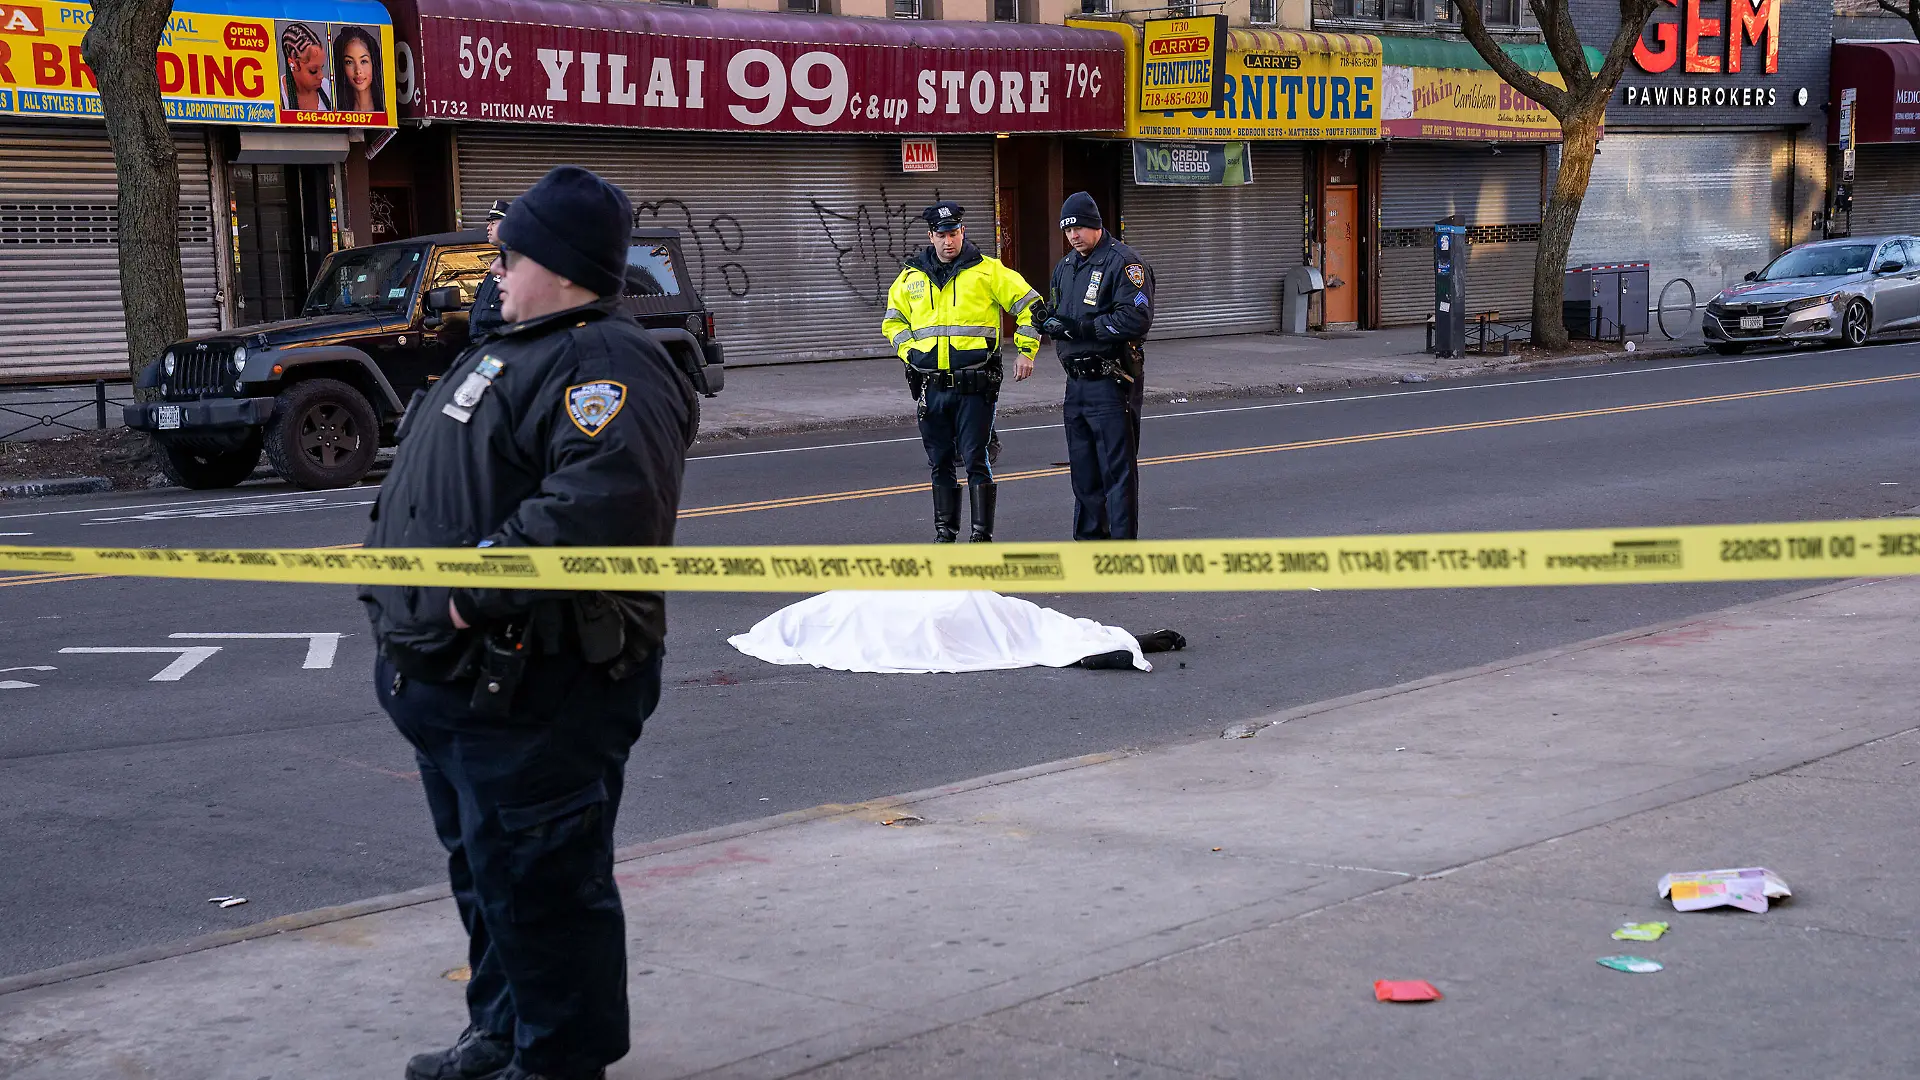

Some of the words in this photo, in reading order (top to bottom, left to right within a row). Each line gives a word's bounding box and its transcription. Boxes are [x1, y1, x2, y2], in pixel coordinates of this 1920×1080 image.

[0, 9, 38, 32] A
[1171, 22, 1189, 32] 1730
[230, 26, 257, 36] OPEN
[1632, 0, 1780, 73] GEM
[230, 38, 237, 46] 7
[239, 38, 265, 48] DAYS
[1151, 37, 1207, 54] LARRY'S
[458, 35, 512, 81] 59¢
[1245, 55, 1298, 68] LARRY'S
[1339, 57, 1378, 68] 718-485-6230
[32, 42, 265, 98] BRDING
[1145, 59, 1211, 86] FURNITURE
[536, 48, 705, 109] YILAI
[916, 70, 1049, 114] STORE
[1064, 62, 1102, 98] 79¢
[1145, 91, 1209, 107] 718-485-6230
[1412, 79, 1453, 112] Pitkin
[1453, 84, 1497, 109] Caribbean
[1627, 86, 1777, 106] PAWNBROKERS
[24, 93, 41, 109] ALL
[42, 95, 75, 112] STYLES
[77, 101, 83, 112] &
[177, 103, 185, 116] &
[186, 103, 245, 119] APPOINTMENTS
[246, 104, 275, 121] Welcome
[430, 100, 468, 115] 1732
[480, 102, 525, 118] PITKIN
[527, 105, 554, 119] AVE
[296, 112, 373, 123] 646-407-9087
[1139, 126, 1161, 135] LIVING
[1163, 127, 1181, 135] ROOM
[1187, 127, 1213, 136] DINNING
[1215, 128, 1232, 136] ROOM
[1237, 128, 1266, 137] BEDROOM
[1267, 128, 1283, 136] SETS
[1288, 128, 1320, 136] MATTRESS
[1325, 127, 1344, 136] YOUTH
[1345, 128, 1377, 136] FURNITURE
[905, 143, 935, 162] ATM
[1146, 148, 1171, 172] NO
[1171, 149, 1209, 162] CREDIT
[1172, 161, 1211, 173] NEEDED
[907, 280, 925, 290] NYPD
